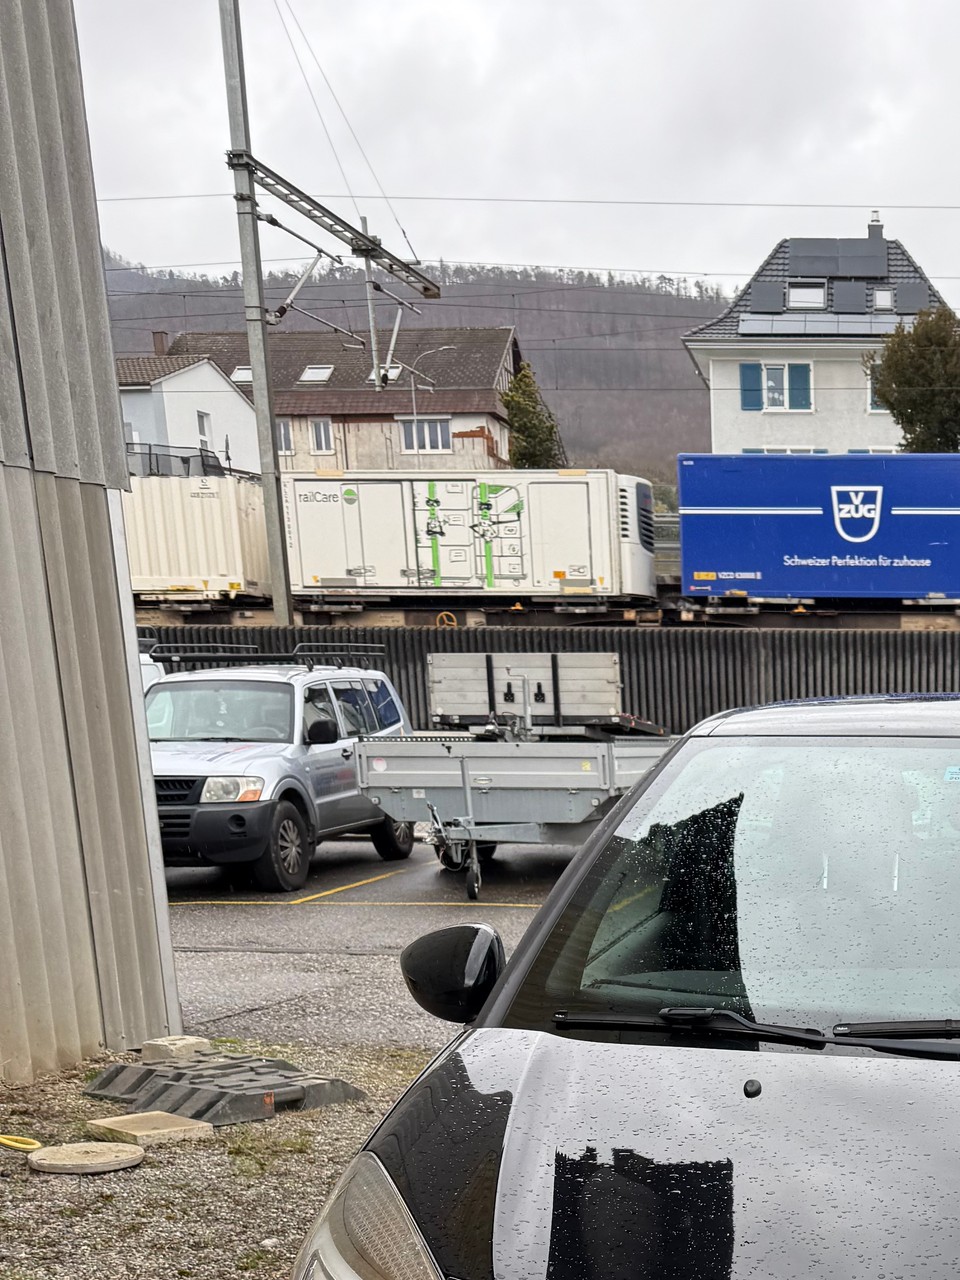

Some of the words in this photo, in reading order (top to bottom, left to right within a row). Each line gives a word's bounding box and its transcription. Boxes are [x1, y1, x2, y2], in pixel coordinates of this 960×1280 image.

[298, 491, 339, 503] railCare
[849, 491, 865, 505] V
[838, 504, 876, 518] ZUG
[783, 555, 830, 566] Schweizer
[831, 555, 878, 567] Perfektion
[878, 555, 891, 566] für
[893, 555, 932, 567] zuhause
